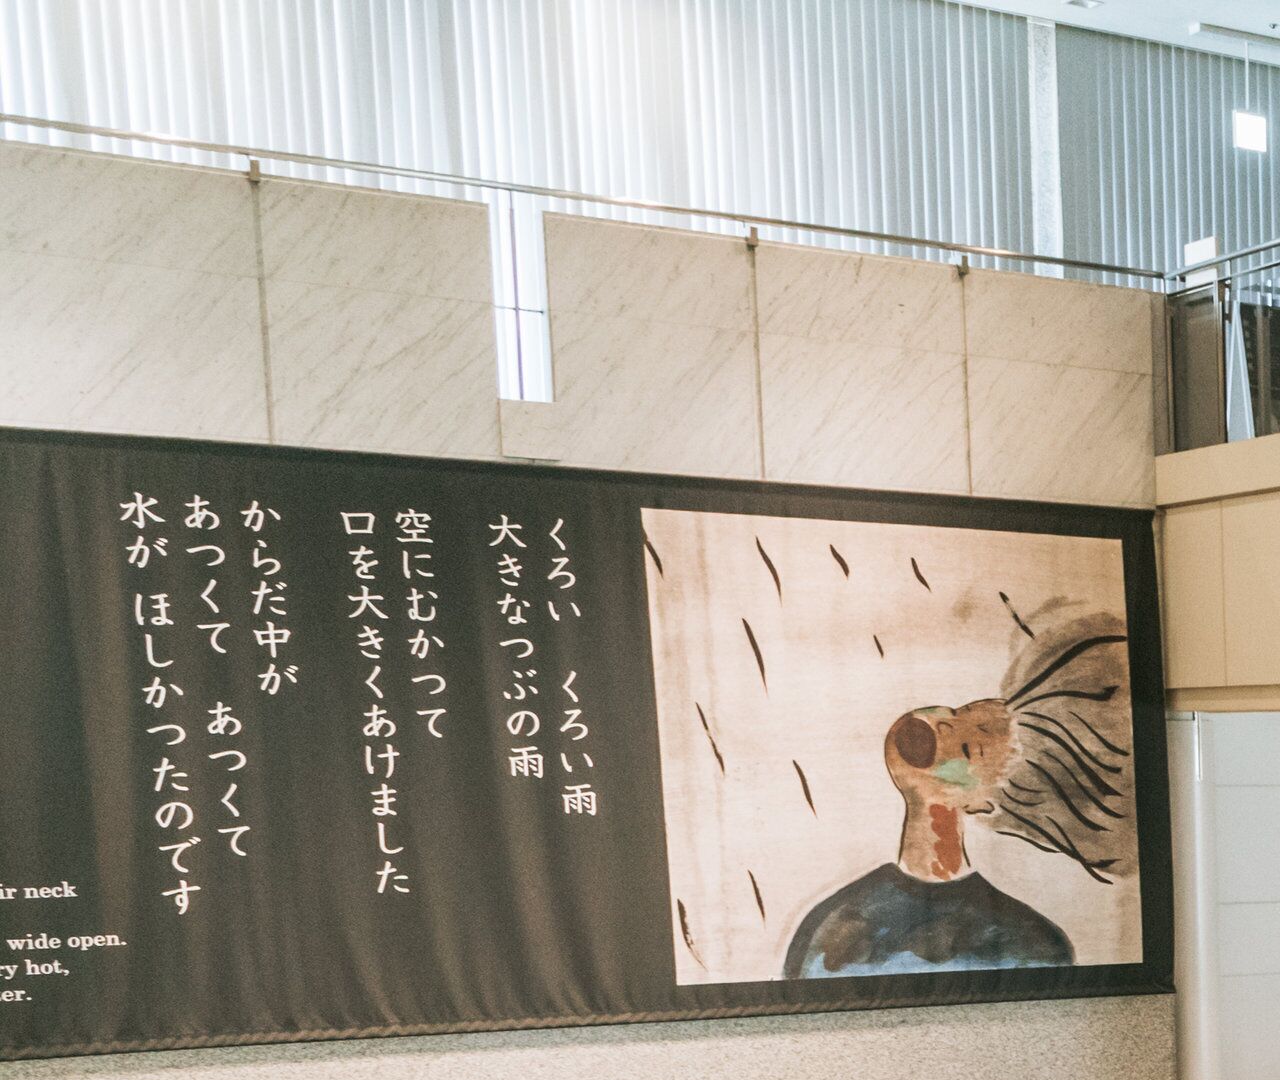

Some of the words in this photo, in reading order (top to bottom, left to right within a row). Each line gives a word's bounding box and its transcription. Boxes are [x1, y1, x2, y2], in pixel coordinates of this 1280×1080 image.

[119, 491, 169, 569] 水が
[184, 494, 231, 654] あつくて
[240, 500, 299, 696] からだ中が
[548, 518, 582, 621] くろい
[340, 511, 410, 894] 口を大きくあけました
[488, 514, 544, 779] 大きなつぶの雨
[207, 701, 251, 857] あつくて
[559, 670, 598, 816] くろい雨
[6, 932, 62, 951] wide
[67, 934, 128, 951] open.
[23, 880, 79, 899] neck
[24, 958, 70, 976] hot,
